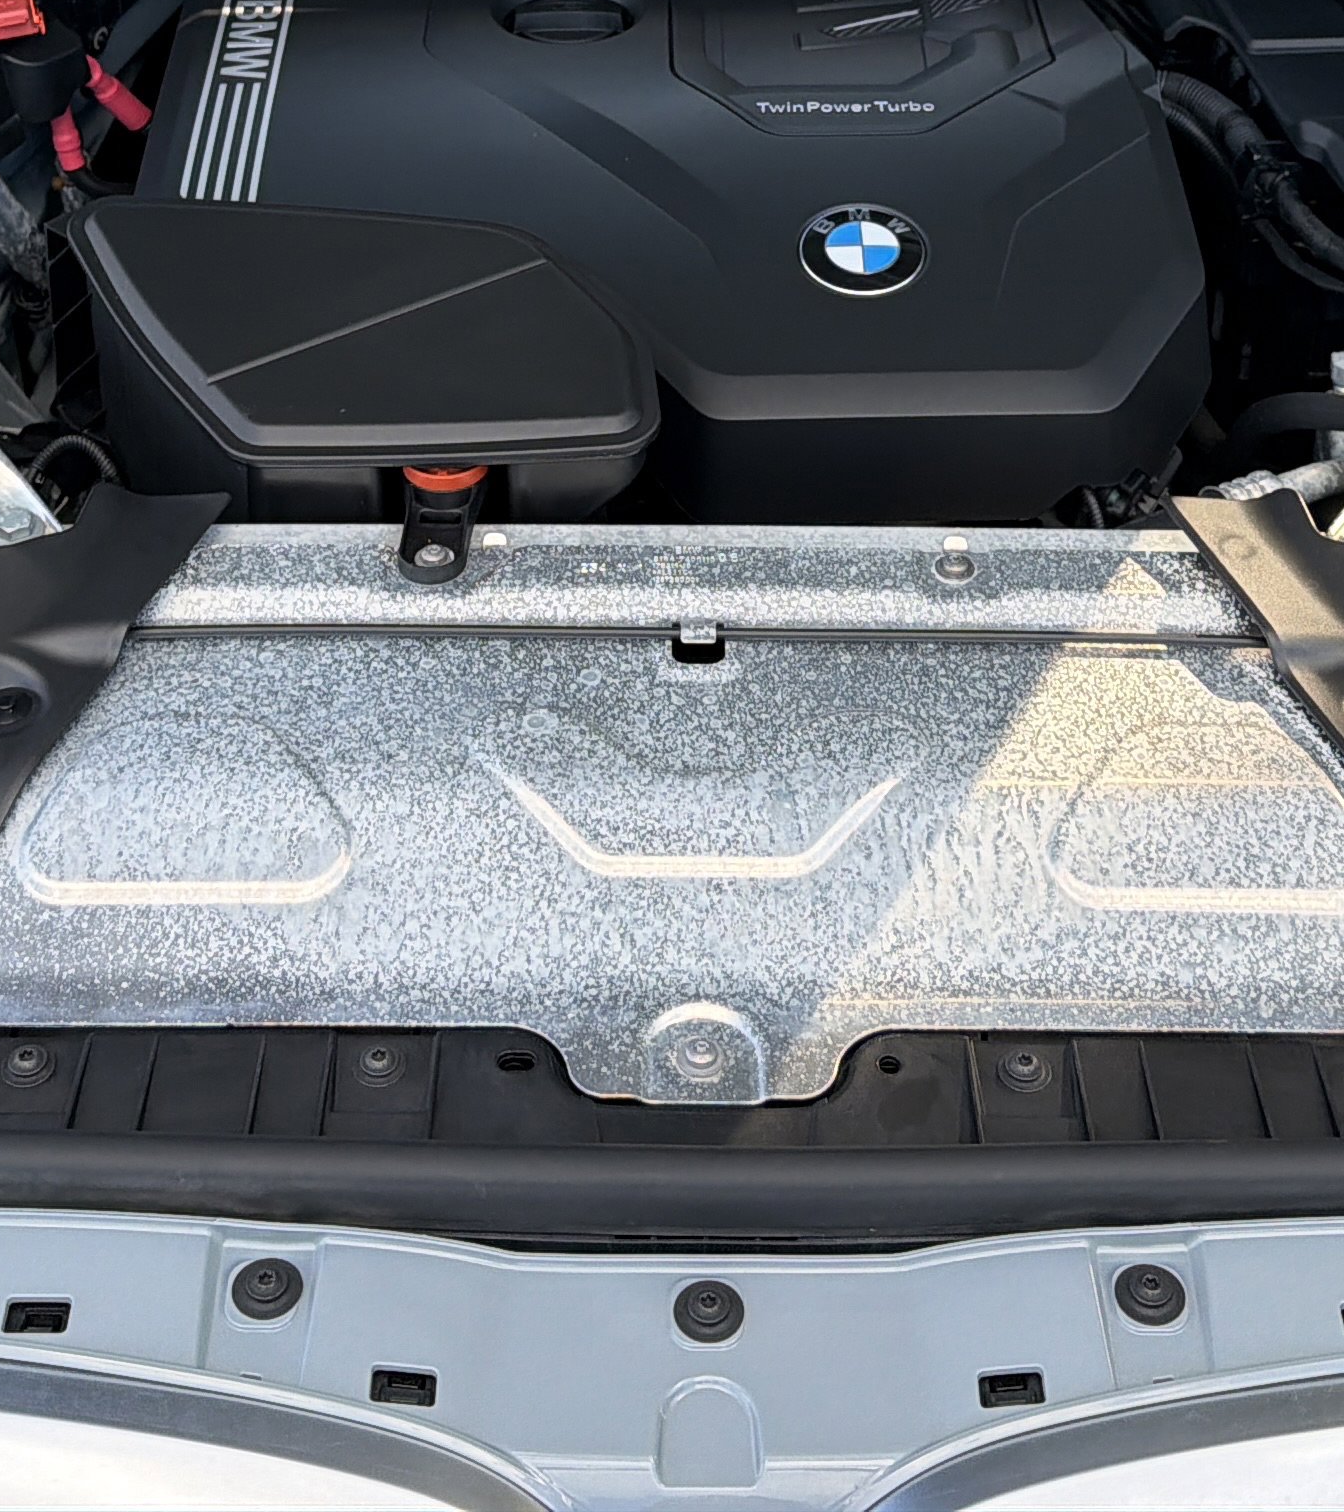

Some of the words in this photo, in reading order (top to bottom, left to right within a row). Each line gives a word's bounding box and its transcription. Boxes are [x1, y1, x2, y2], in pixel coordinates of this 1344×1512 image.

[219, 0, 283, 79] BMW
[873, 100, 935, 113] Turbo
[812, 207, 911, 235] BMW
